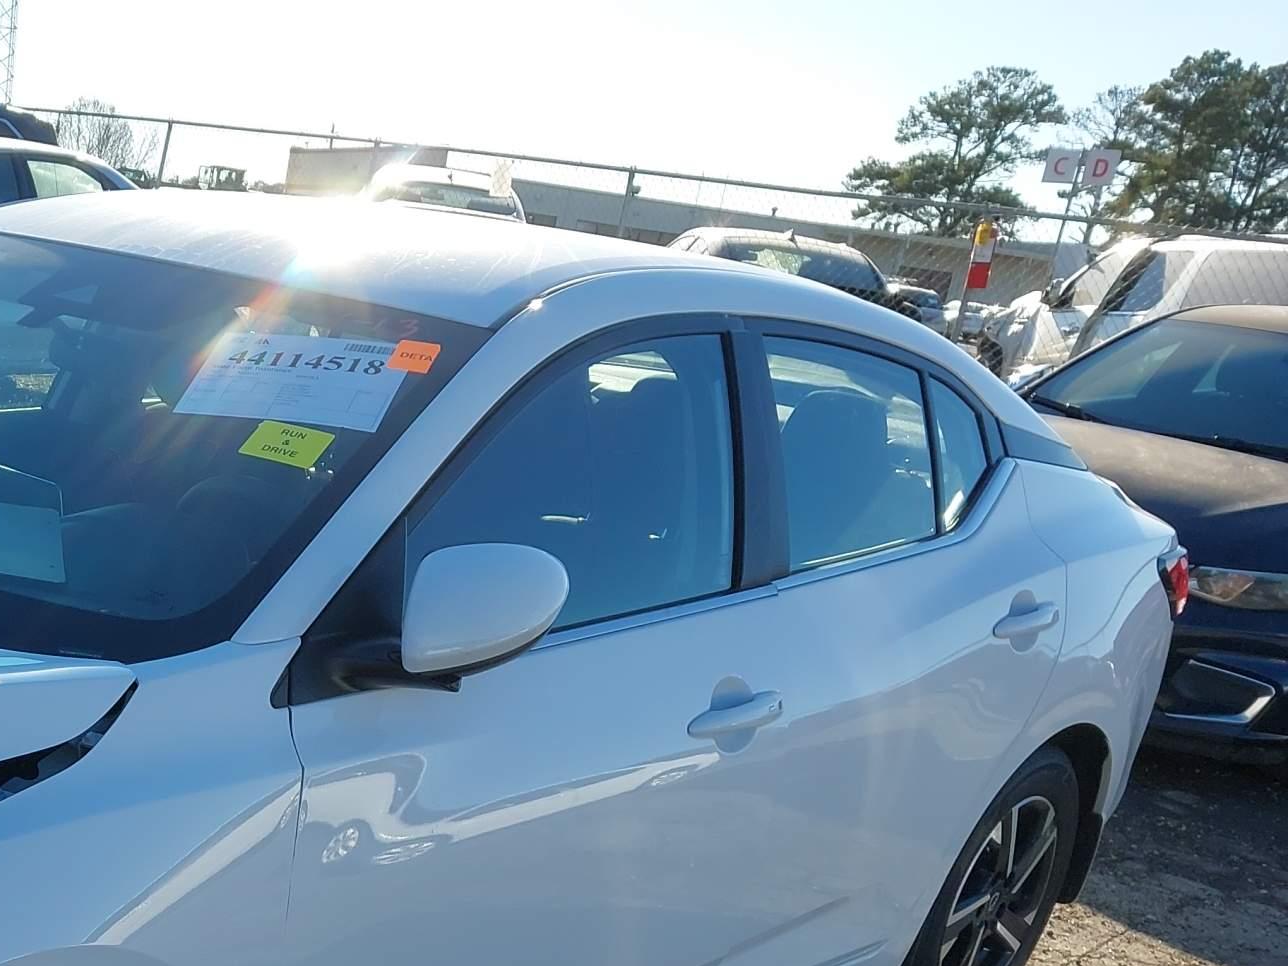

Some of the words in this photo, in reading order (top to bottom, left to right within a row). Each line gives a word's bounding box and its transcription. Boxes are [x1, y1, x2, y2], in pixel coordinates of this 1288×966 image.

[1054, 156, 1069, 176] C
[1092, 159, 1109, 177] D
[228, 349, 385, 376] 44114518
[280, 428, 307, 440] RUN
[261, 444, 299, 458] DRIVE
